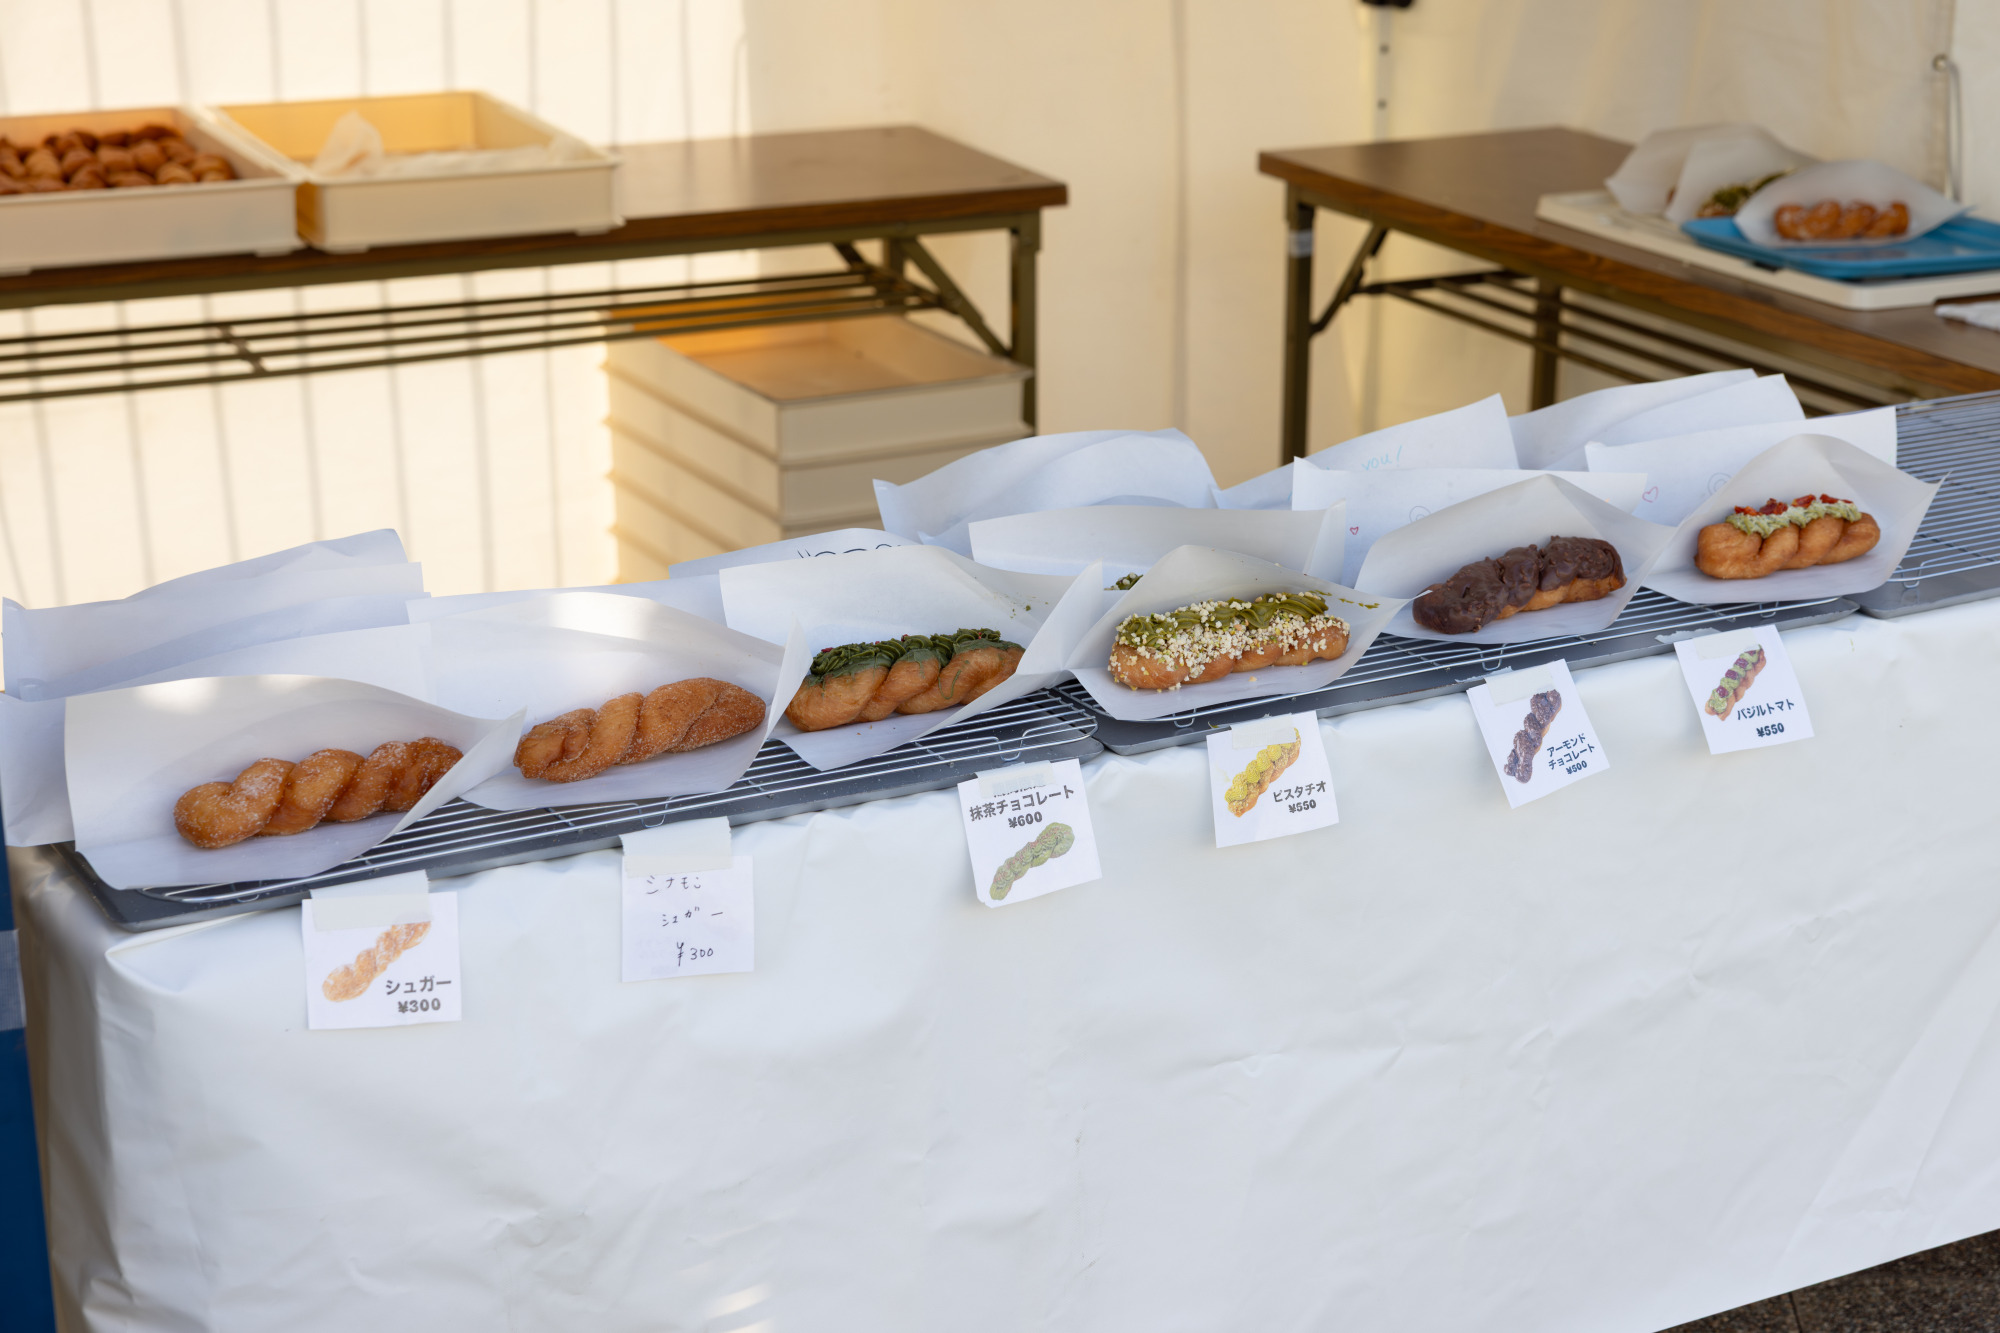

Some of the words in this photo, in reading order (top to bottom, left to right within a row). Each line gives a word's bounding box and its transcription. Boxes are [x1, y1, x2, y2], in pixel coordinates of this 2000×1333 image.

[1736, 698, 1795, 721] バジルトマト
[1756, 722, 1785, 738] ¥550
[1546, 733, 1587, 757] アーモンド
[1548, 743, 1596, 771] チョコレート
[1565, 760, 1588, 775] ¥500
[969, 784, 1075, 823] 抹茶チョコレート
[1288, 799, 1317, 814] ¥550
[1007, 811, 1043, 829] ¥600
[385, 974, 452, 996] シュガー
[397, 997, 442, 1014] ¥300
